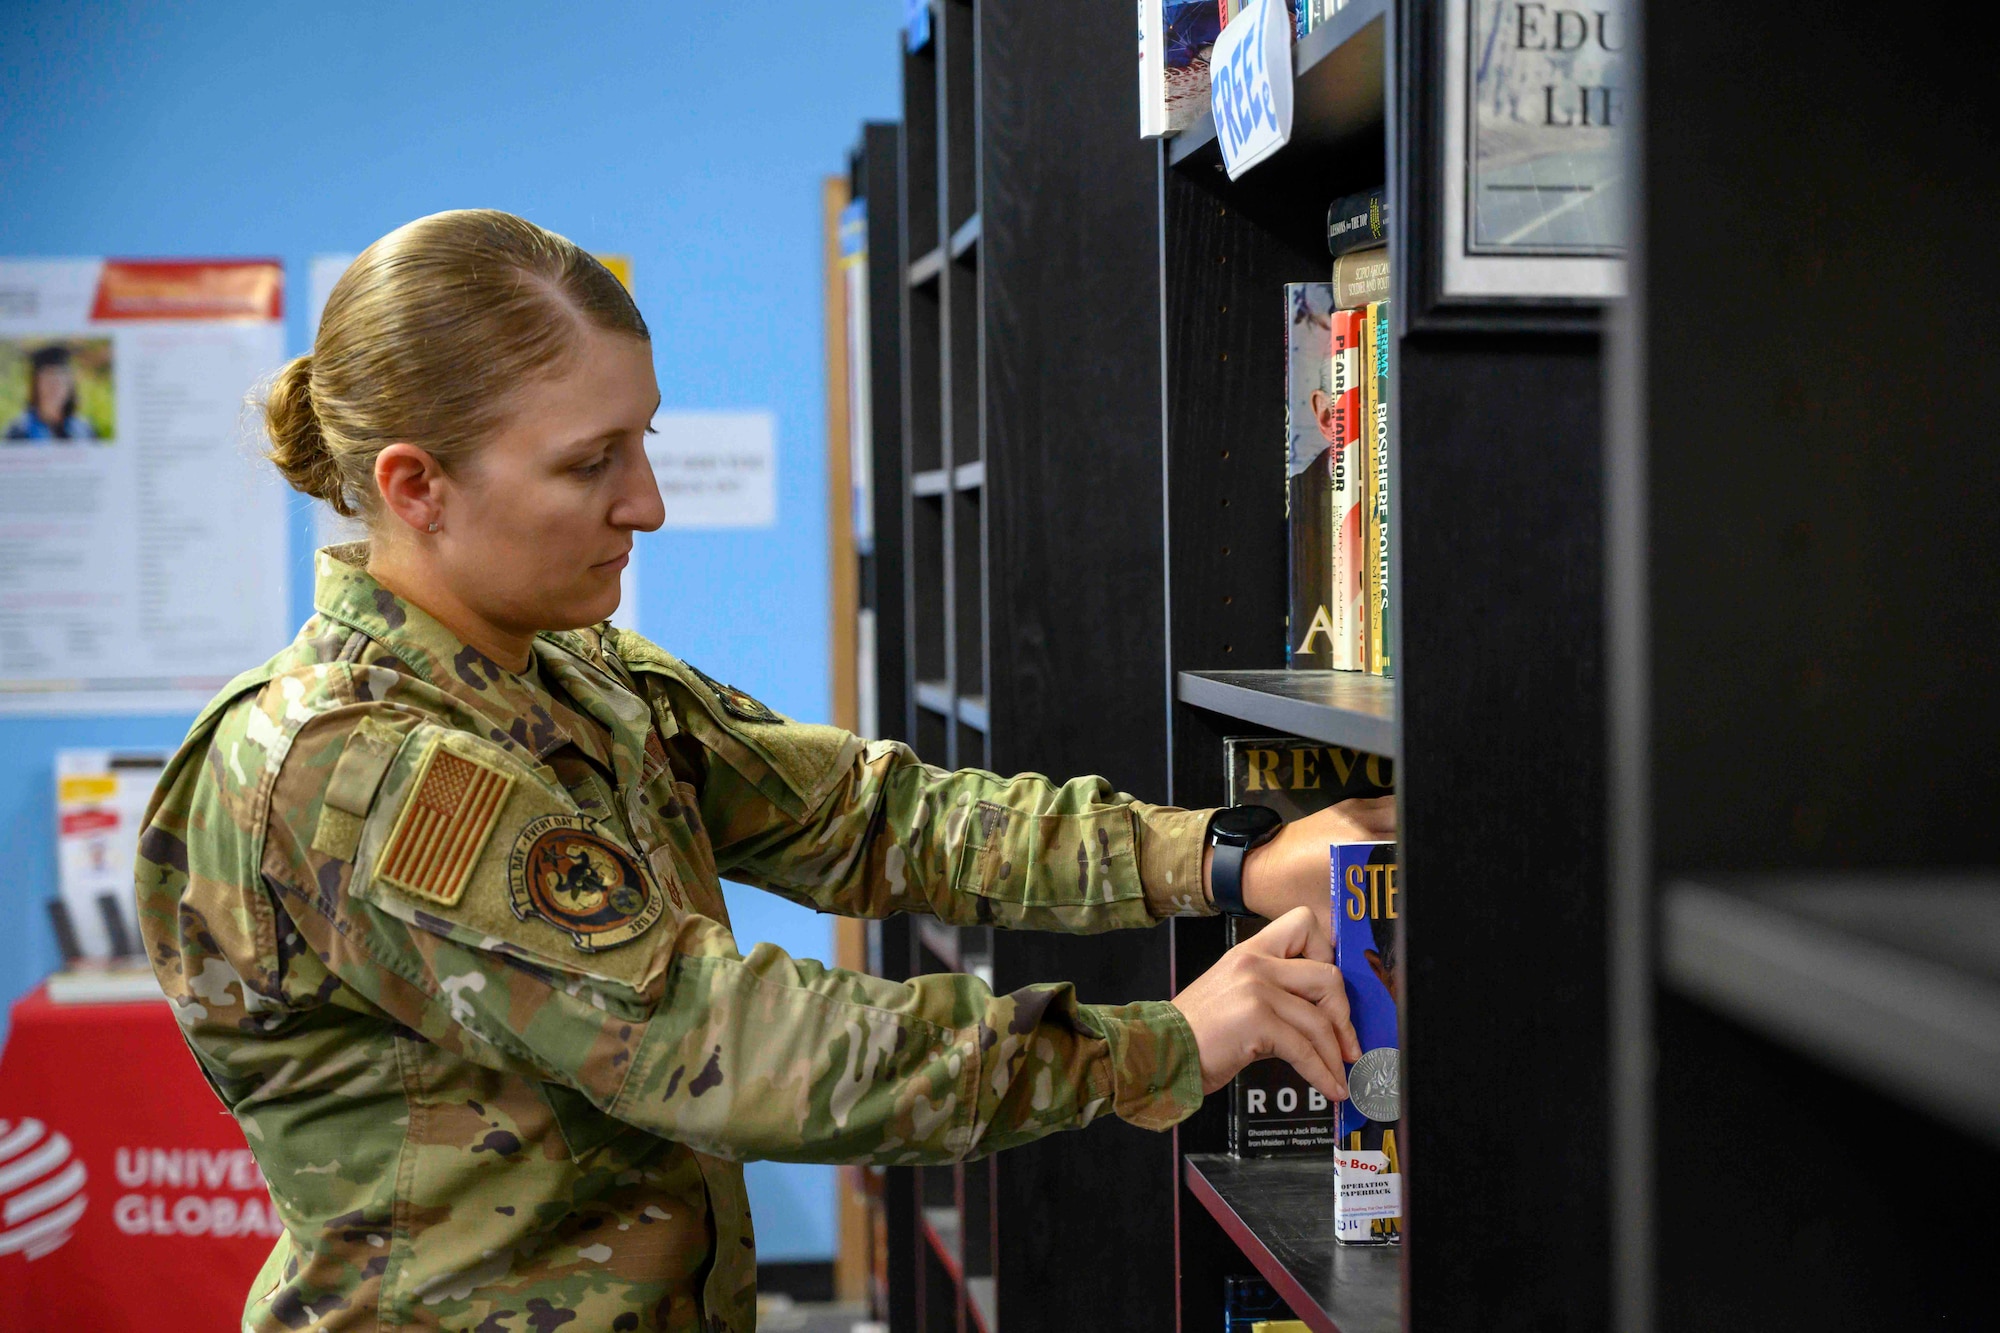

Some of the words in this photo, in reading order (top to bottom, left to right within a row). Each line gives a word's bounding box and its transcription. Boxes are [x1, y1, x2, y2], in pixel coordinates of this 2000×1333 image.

[1351, 216, 1360, 231] THE
[1359, 213, 1368, 228] TOP
[1380, 318, 1389, 379] JEREMY
[1335, 335, 1345, 397] PEARL
[1335, 408, 1345, 492] HARBOR
[1377, 402, 1388, 516] BIOSPHERE
[1379, 523, 1389, 610] POLITICS
[524, 817, 553, 842] EVERY
[554, 815, 573, 828] DAY
[511, 849, 526, 871] DAY
[511, 874, 526, 895] ALL
[1345, 863, 1398, 921] STE
[1248, 1128, 1289, 1138] Ghostemane
[1294, 1127, 1310, 1135] Jack
[1310, 1126, 1328, 1134] Black
[1248, 1140, 1261, 1148] Iron
[1261, 1139, 1285, 1148] Maiden
[1292, 1138, 1312, 1148] Poppy
[115, 1146, 268, 1191] UNIVE
[1340, 1188, 1391, 1198] PAPERBACK
[1341, 1181, 1389, 1190] OPERATION
